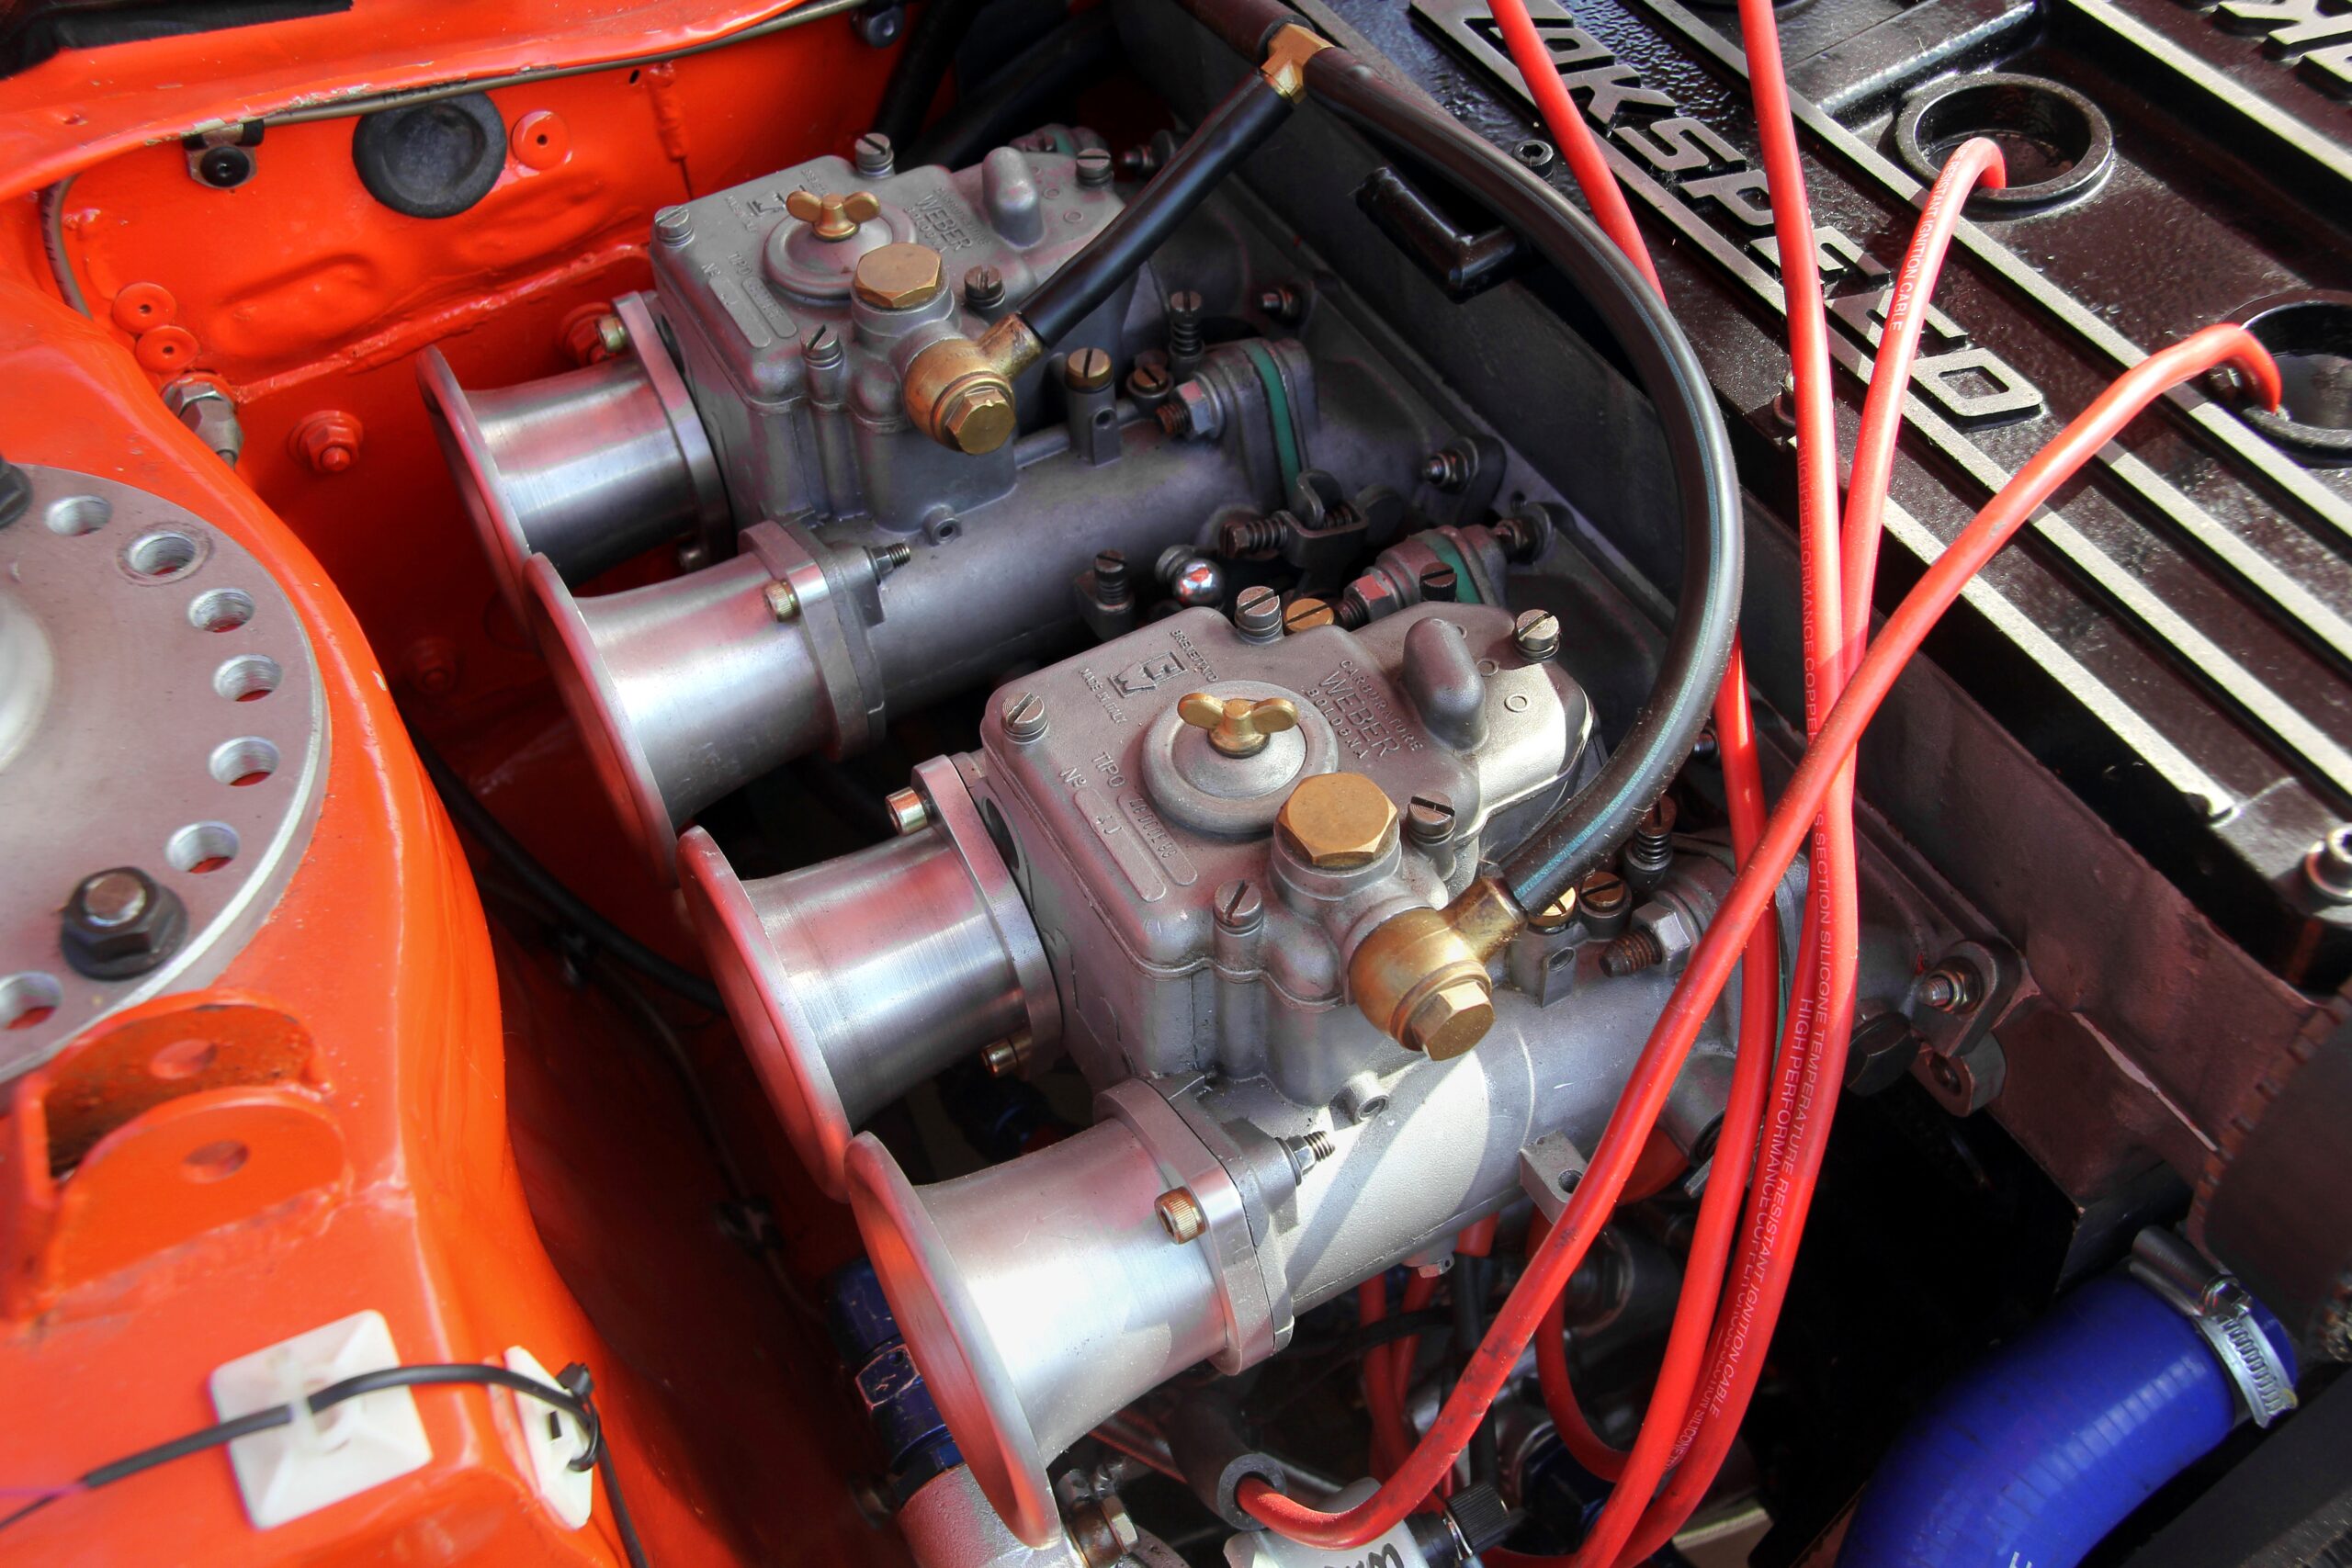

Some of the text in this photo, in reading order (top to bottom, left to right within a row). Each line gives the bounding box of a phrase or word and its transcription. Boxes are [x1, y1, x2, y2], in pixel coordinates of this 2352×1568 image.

[915, 194, 972, 251] WEBER
[1926, 161, 1962, 218] RESISTANT
[1905, 219, 1936, 278] IGNITION
[1889, 280, 1914, 332] CABLE
[1800, 498, 1815, 654] PERFORMANCE
[1306, 688, 1369, 759] BOLOGNA
[1319, 671, 1399, 757] WEBER
[1340, 660, 1423, 751] CARBURATORE
[1091, 751, 1125, 787] TIPO
[1815, 832, 1831, 924] SECTION
[1815, 931, 1831, 1024] SILICONE
[1792, 998, 1814, 1051] HIGH
[1758, 1055, 1803, 1208] PERFORMANCE
[1781, 1030, 1826, 1176] TEMPERATURE
[1754, 1178, 1790, 1283] RESISTANT
[1729, 1282, 1760, 1363] IGNITION
[1709, 1363, 1735, 1418] CABLE
